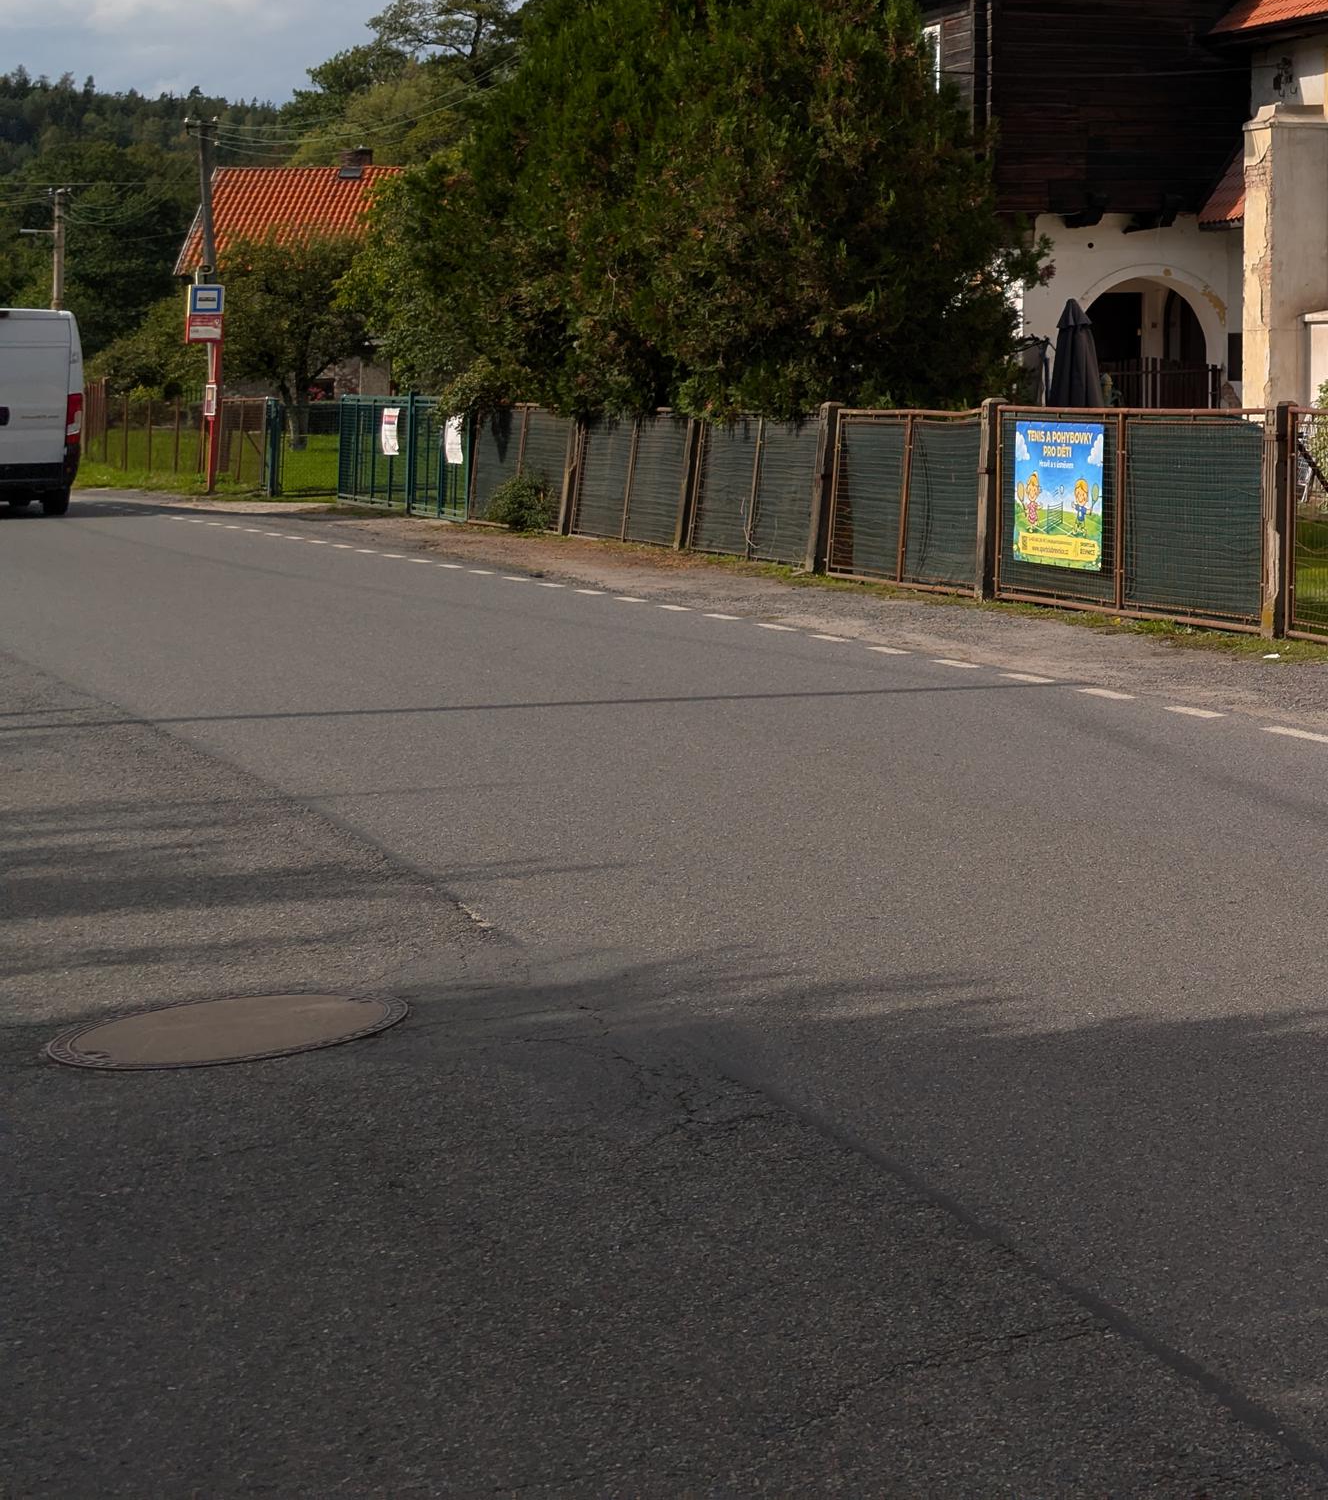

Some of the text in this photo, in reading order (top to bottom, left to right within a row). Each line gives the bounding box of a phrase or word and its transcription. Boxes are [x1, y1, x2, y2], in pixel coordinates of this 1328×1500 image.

[1027, 430, 1093, 444] TENIS A POHYBOVKY
[1043, 443, 1072, 458] PRO DĚTI
